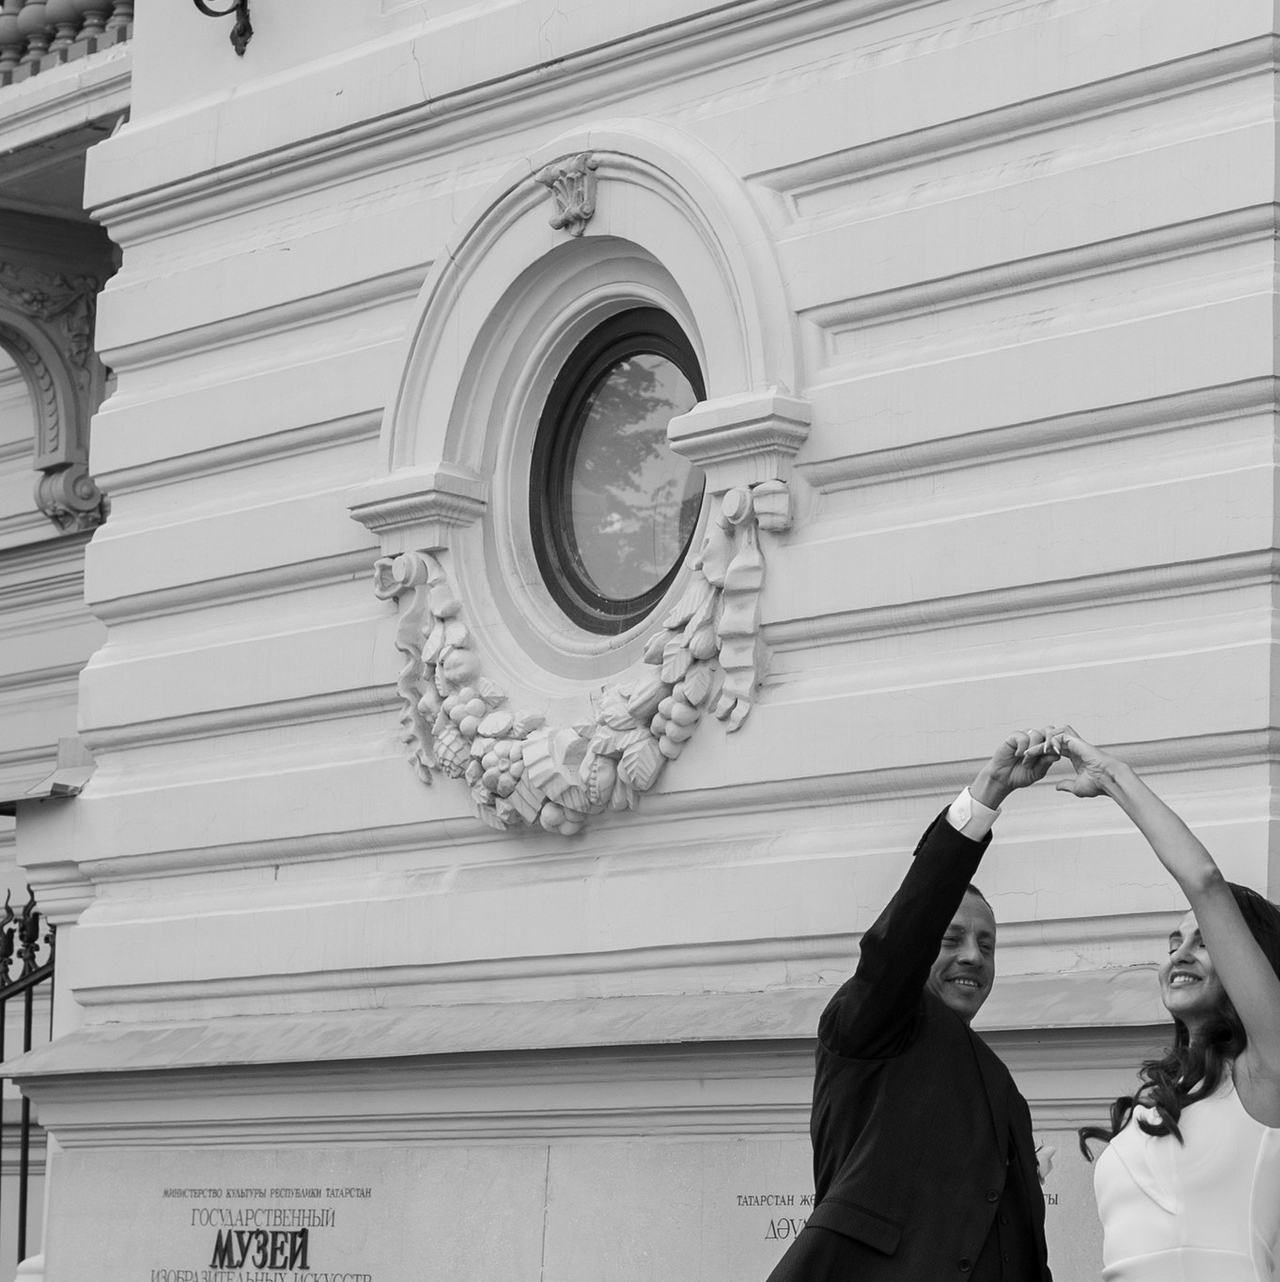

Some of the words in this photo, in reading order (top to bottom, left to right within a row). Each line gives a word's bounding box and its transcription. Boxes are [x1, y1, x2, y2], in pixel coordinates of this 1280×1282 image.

[162, 1188, 222, 1199] МИНИСТЕРСТВО
[226, 1188, 267, 1199] КУЛЬТУРЫ
[270, 1188, 321, 1199] РЕСПУБЛИКИ
[326, 1188, 371, 1199] ТАТАРСТАН
[736, 1194, 795, 1206] ТАТАРСТАН
[191, 1207, 335, 1227] ГОСУДАРСТВЕННЫЙ
[209, 1228, 310, 1271] МУЗЕЙ
